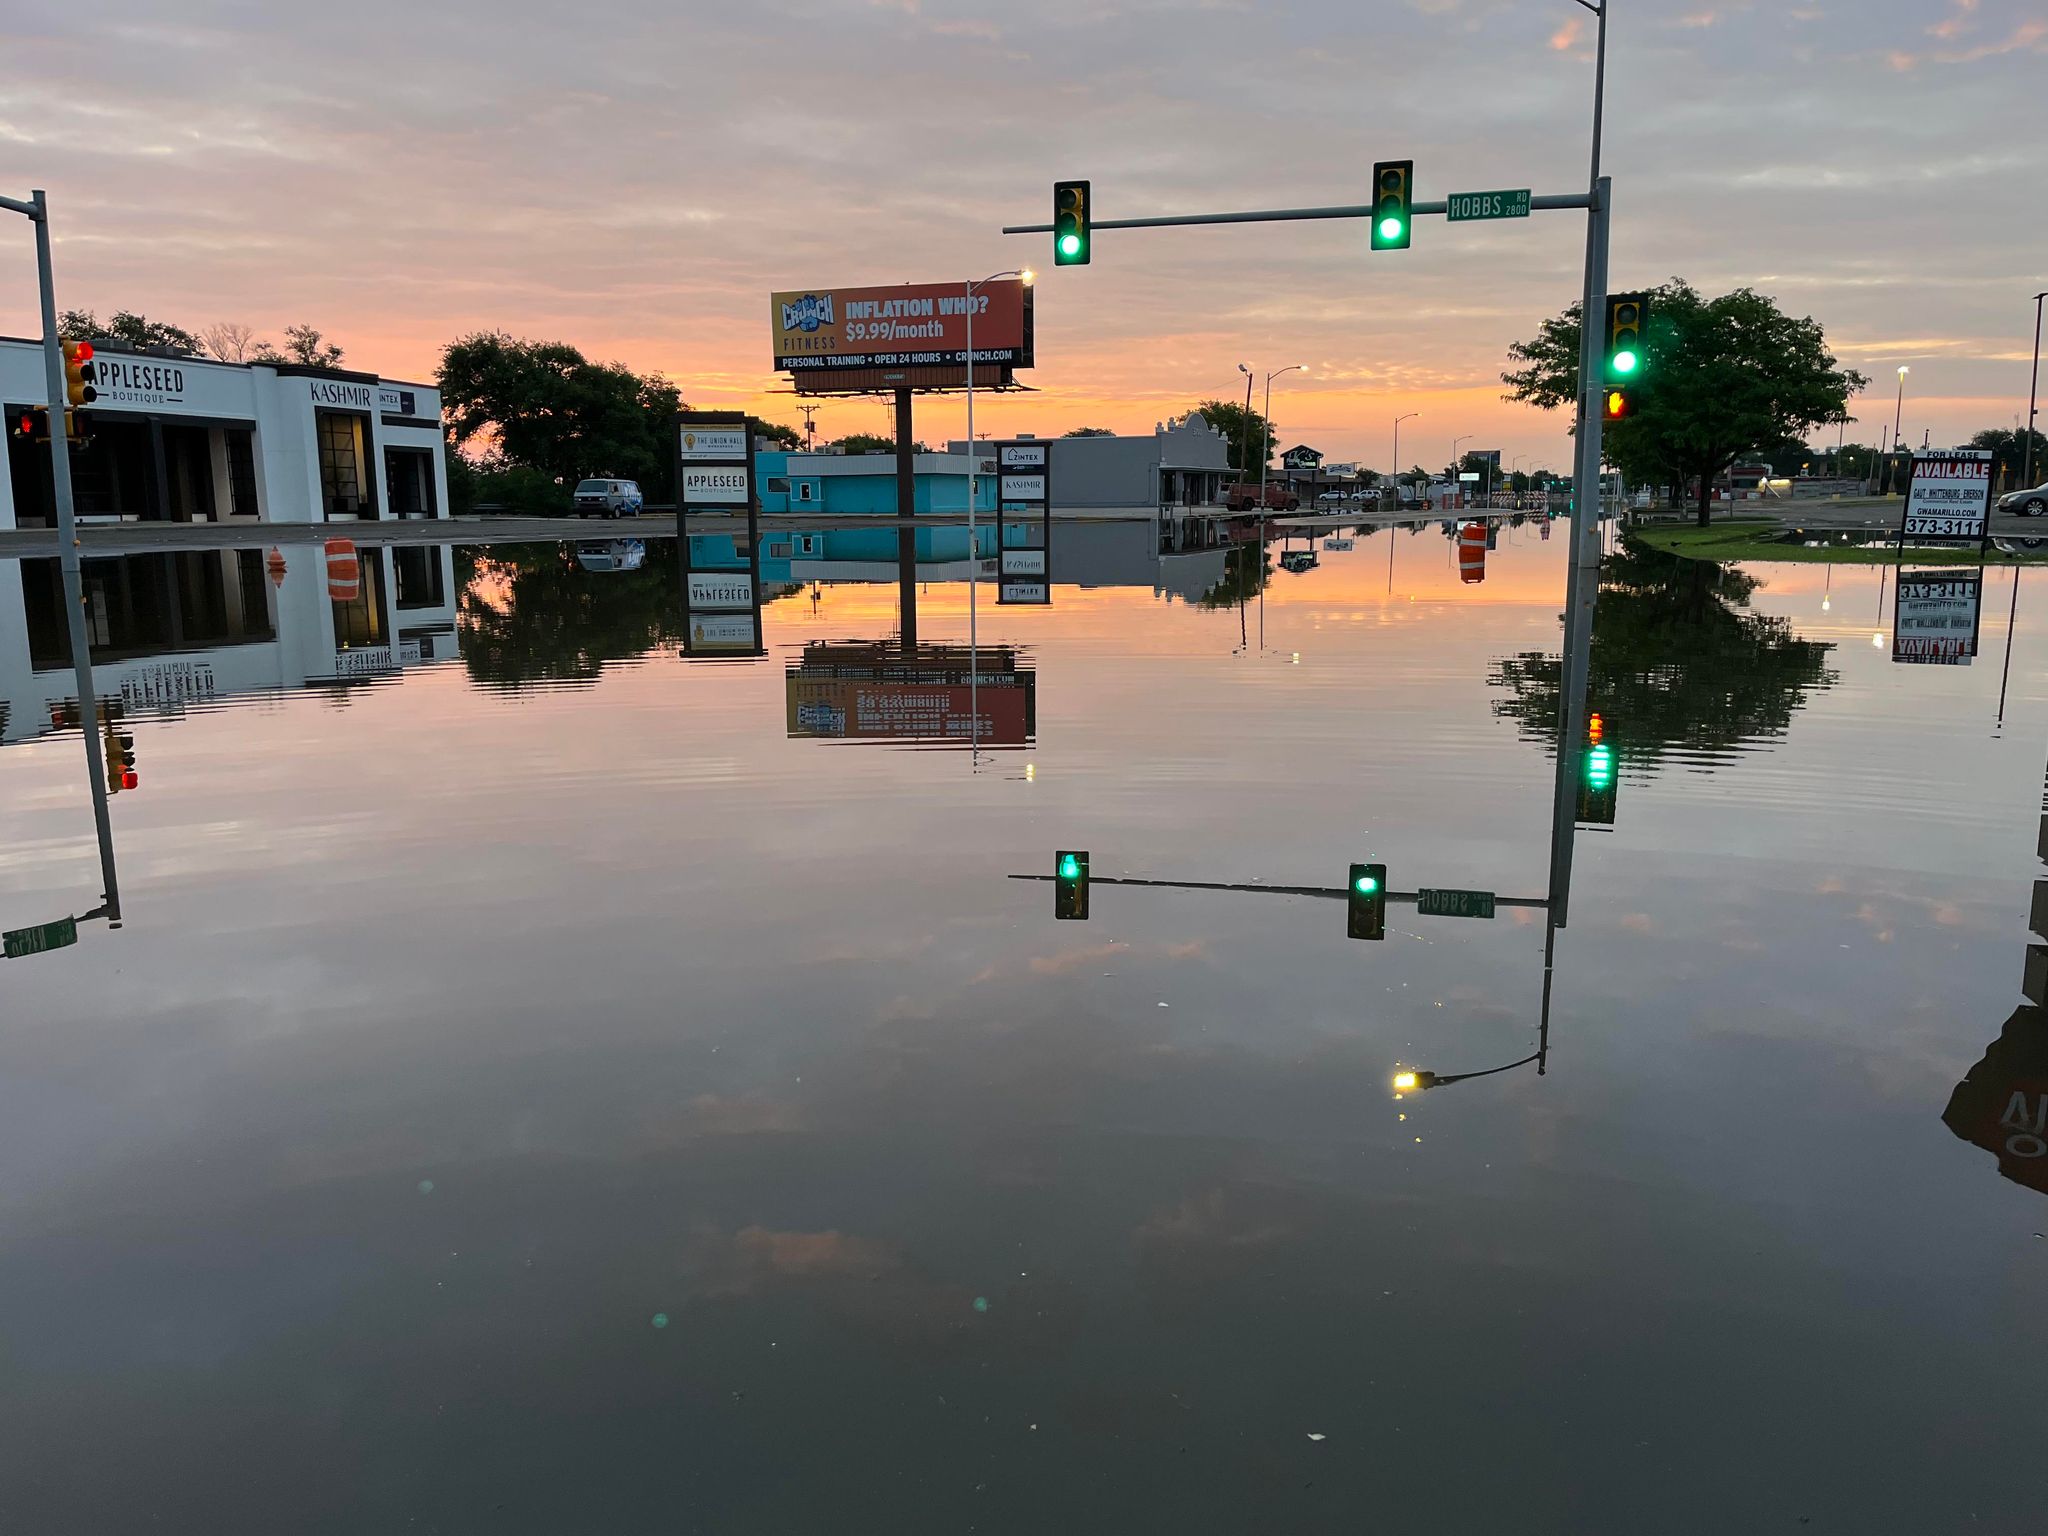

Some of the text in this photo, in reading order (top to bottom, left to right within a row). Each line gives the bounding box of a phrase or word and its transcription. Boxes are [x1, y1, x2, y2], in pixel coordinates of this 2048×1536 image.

[1451, 192, 1527, 217] HOBBS RD
[1506, 205, 1526, 215] 2800
[782, 294, 834, 331] CRUNCH
[846, 296, 989, 319] INFLATION WHO?
[846, 320, 944, 342] $9.99/month
[784, 337, 836, 351] FITNESS
[783, 357, 824, 367] PERSONAL
[826, 355, 865, 366] TRAINING
[875, 354, 897, 364] OPEN
[899, 354, 910, 363] 24
[912, 353, 941, 363] HOURS
[89, 361, 183, 392] APPLESEED
[112, 391, 164, 404] BOUTIQUE
[310, 382, 371, 407] KASHMIR
[1914, 462, 1990, 479] AVAILABLE
[688, 476, 744, 487] APPLESEED
[1006, 481, 1041, 489] KASHMIR
[1917, 508, 1977, 517] GWAMARILLO.COM
[1907, 519, 1984, 535] 373-3111
